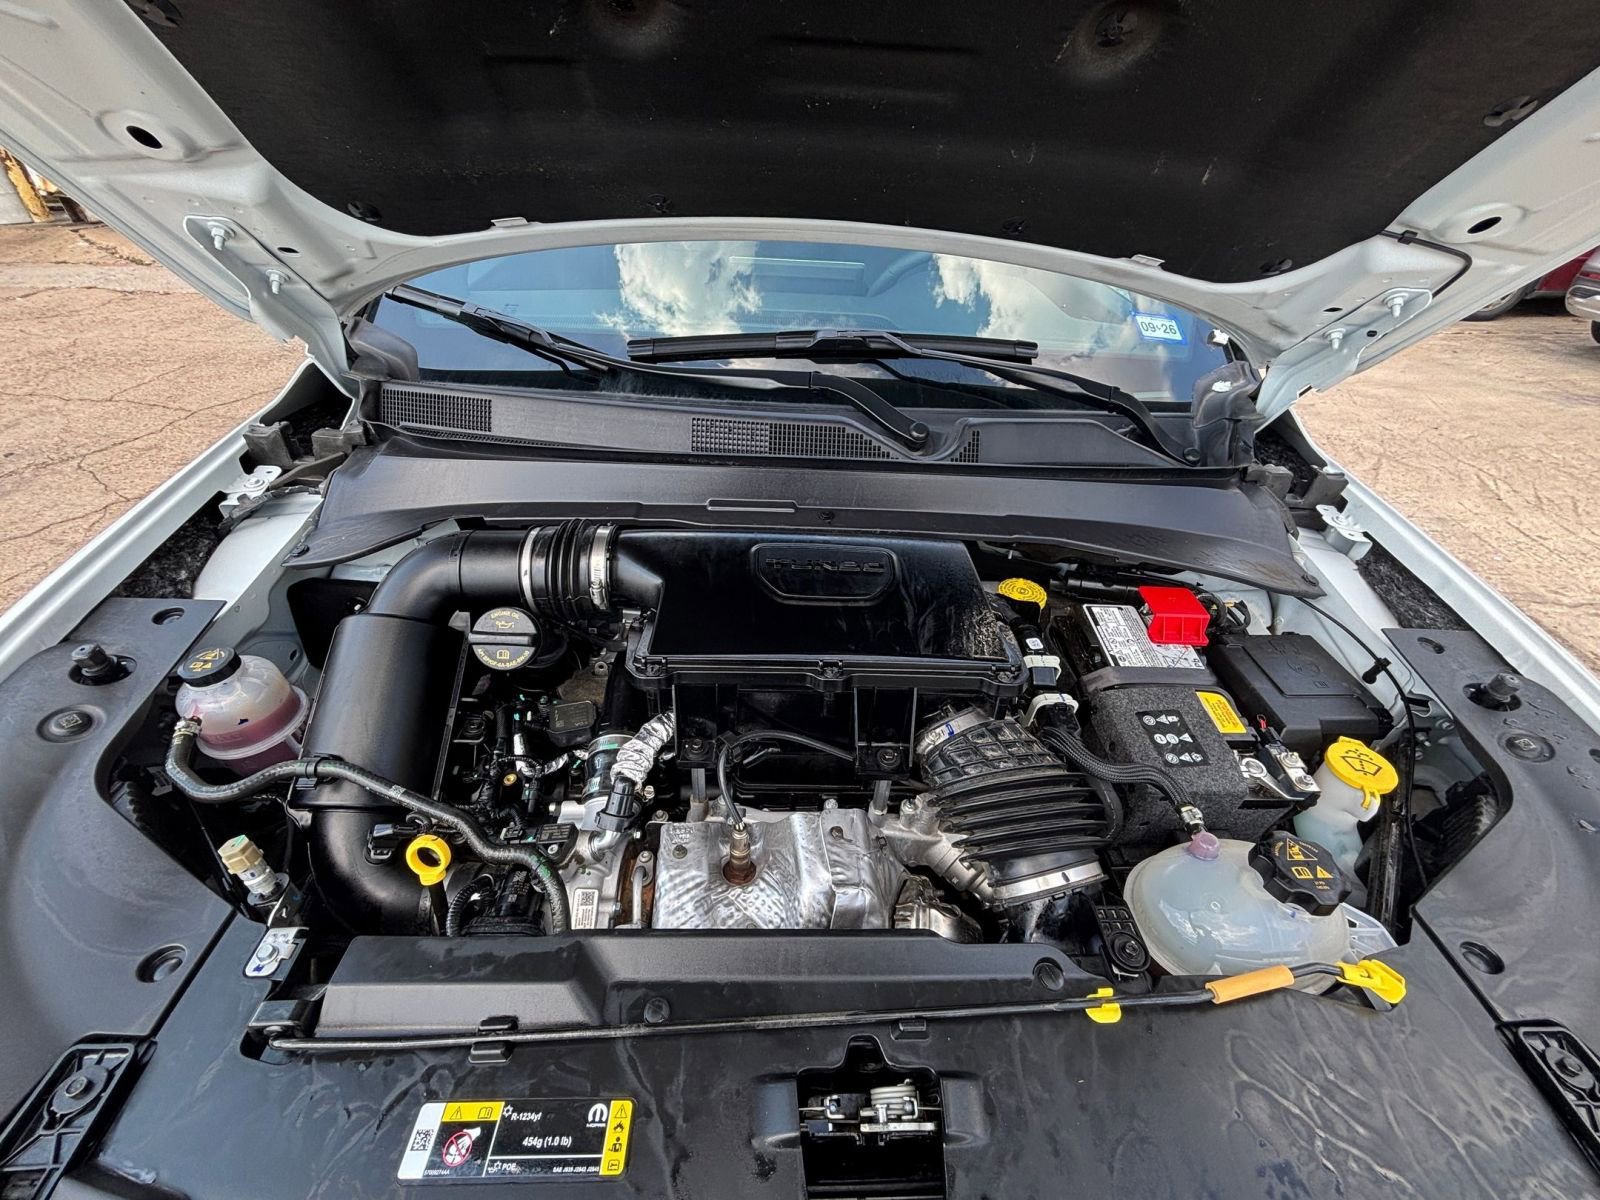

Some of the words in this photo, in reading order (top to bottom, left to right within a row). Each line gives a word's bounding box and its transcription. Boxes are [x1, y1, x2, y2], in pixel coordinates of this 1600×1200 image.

[490, 610, 511, 619] ENGINE
[510, 1112, 542, 1122] R-1234yf
[522, 1136, 543, 1148] 454g
[543, 1136, 560, 1148] (1.0
[560, 1136, 572, 1148] lb)
